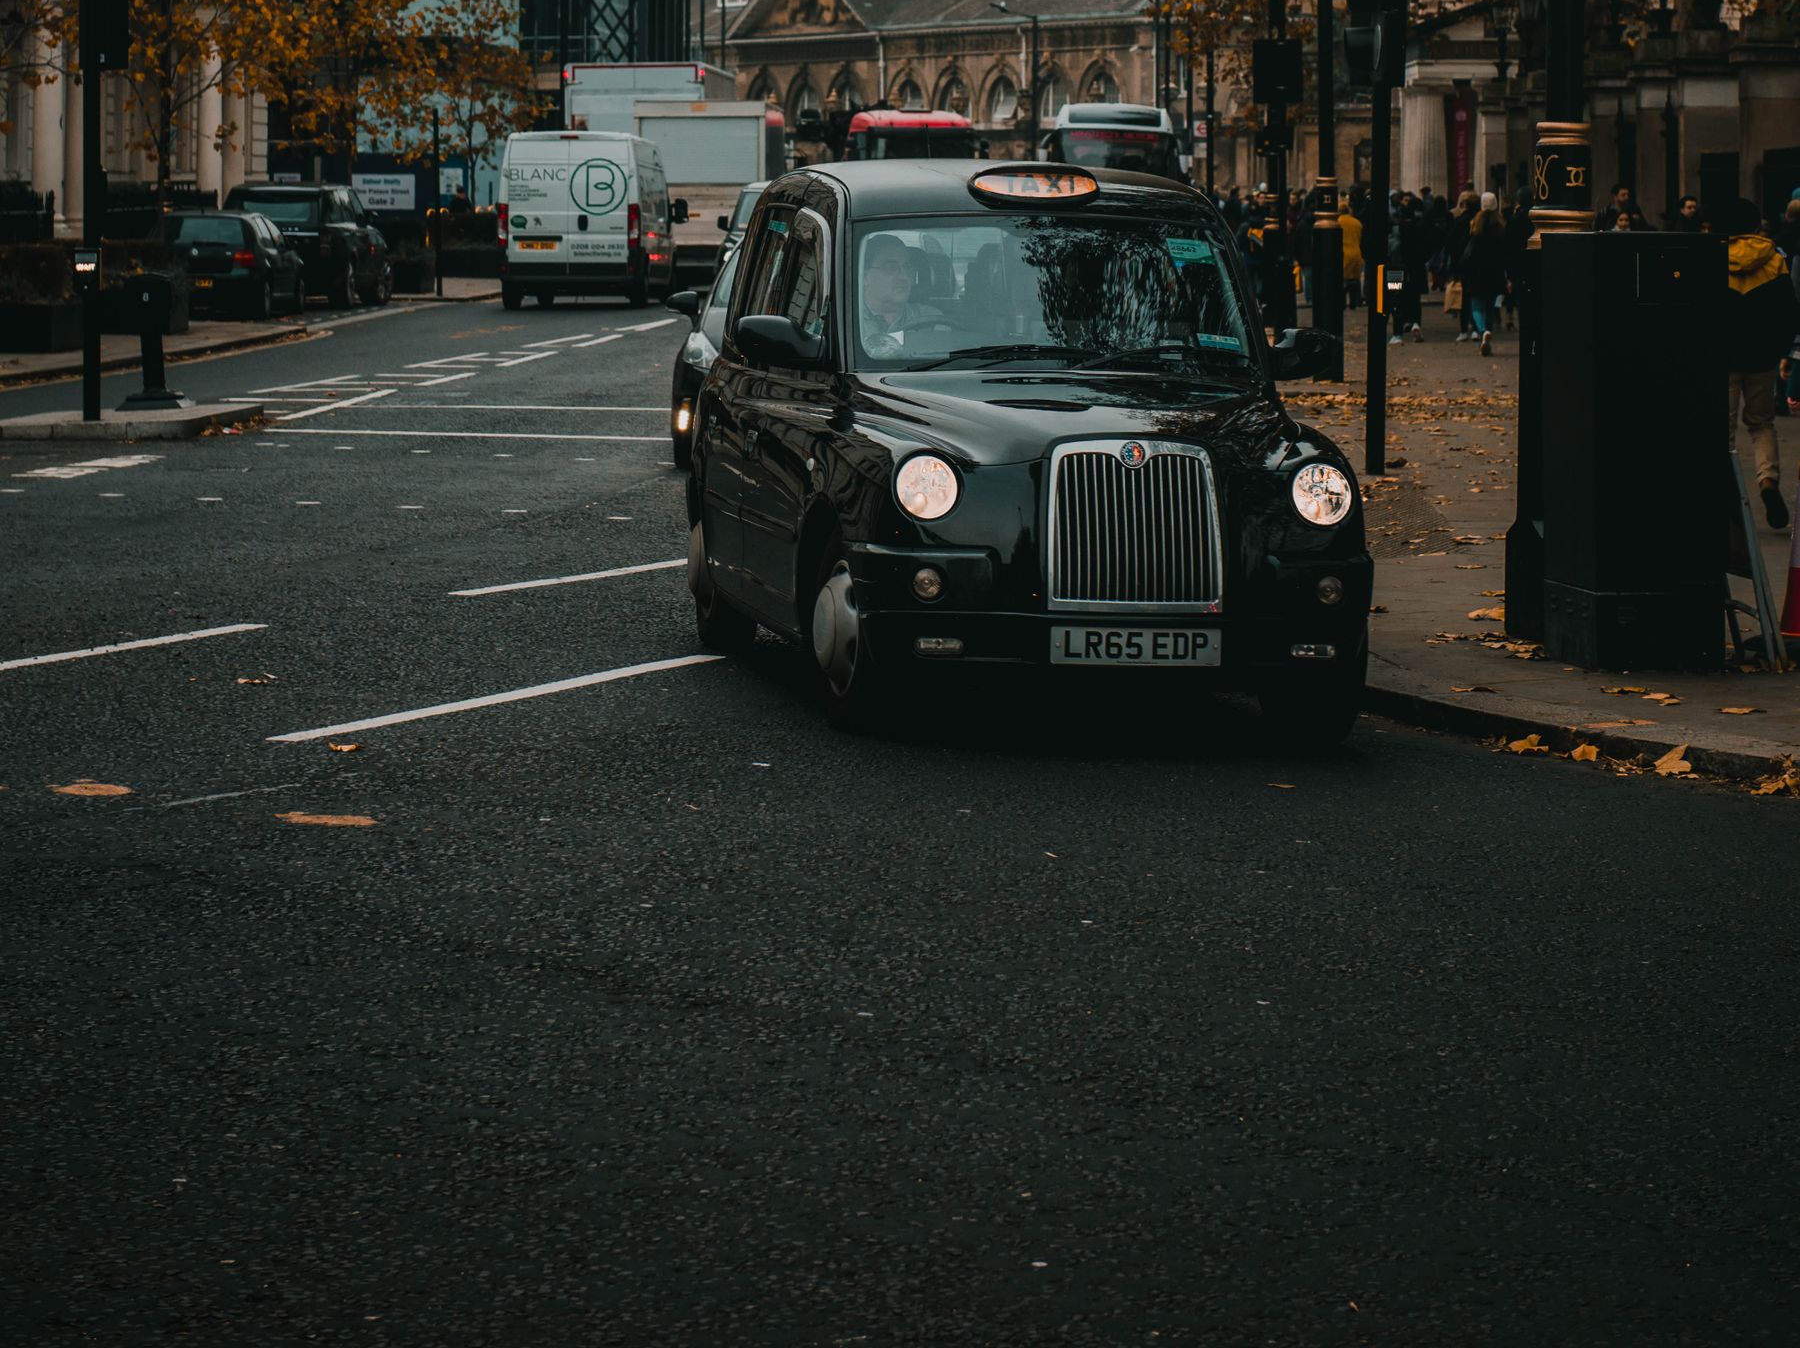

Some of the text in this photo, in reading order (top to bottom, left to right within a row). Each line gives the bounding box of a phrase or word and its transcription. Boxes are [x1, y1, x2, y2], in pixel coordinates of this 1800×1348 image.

[509, 168, 567, 182] BLANC
[1007, 173, 1076, 194] TAXI
[75, 262, 96, 272] WAIT
[1387, 281, 1403, 291] WAIT
[1063, 629, 1208, 661] LR65 EDP
